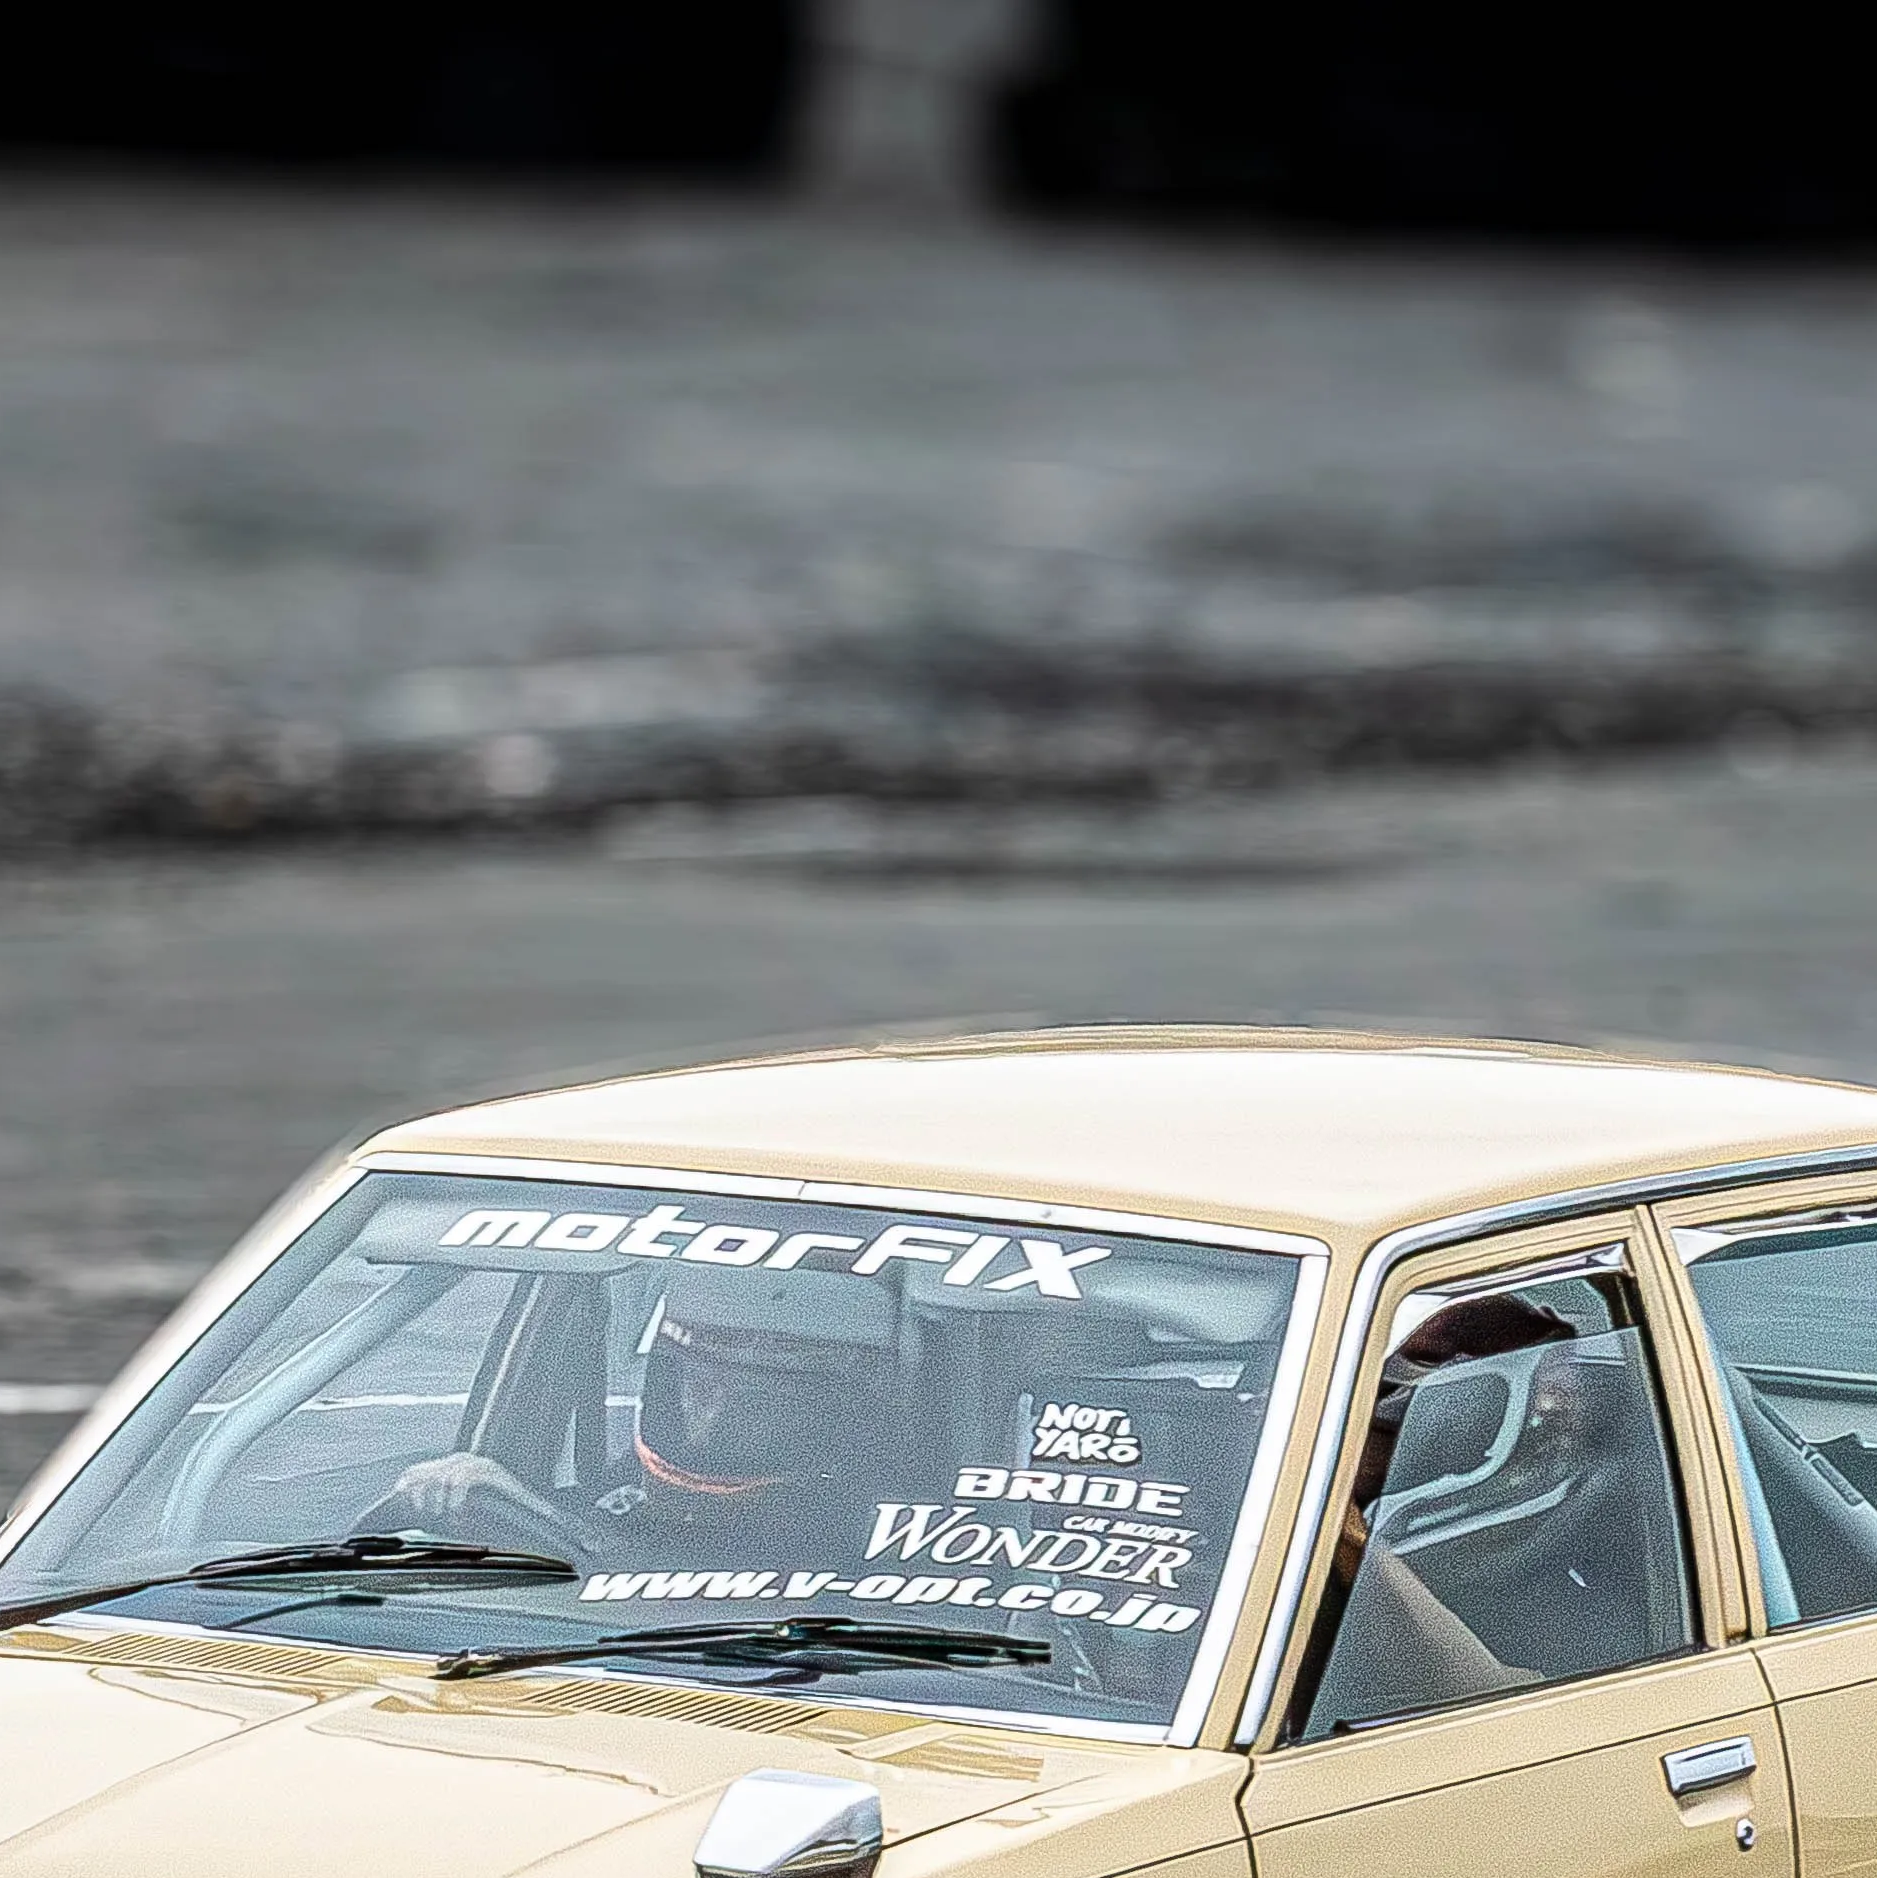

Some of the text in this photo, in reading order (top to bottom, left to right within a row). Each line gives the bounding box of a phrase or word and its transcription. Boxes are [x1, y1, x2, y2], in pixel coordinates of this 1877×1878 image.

[954, 1467, 1191, 1517] BRIDE
[864, 1503, 1194, 1589] WONDER
[578, 1570, 1203, 1633] www.v-opt.co.jp
